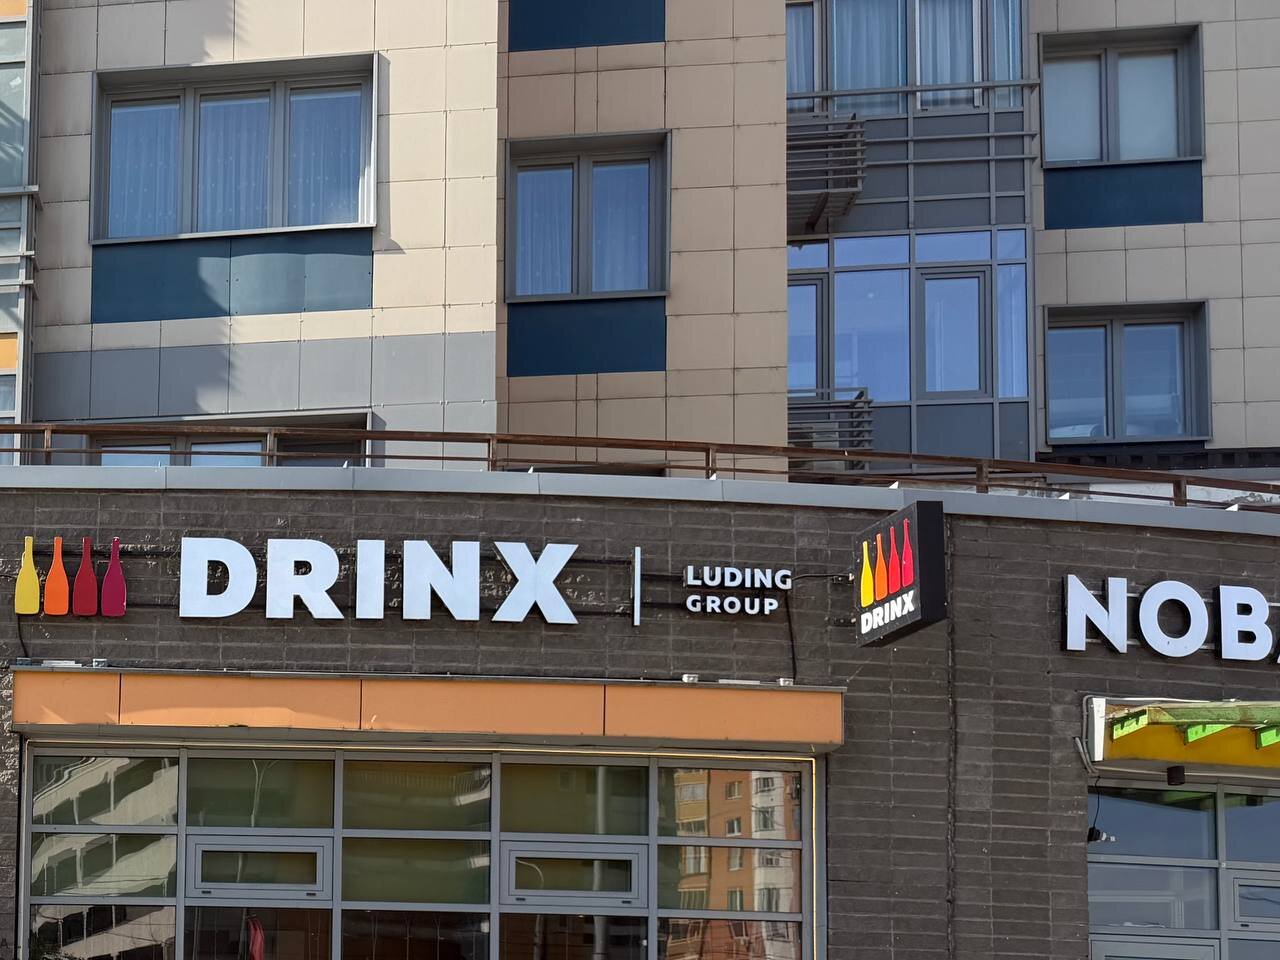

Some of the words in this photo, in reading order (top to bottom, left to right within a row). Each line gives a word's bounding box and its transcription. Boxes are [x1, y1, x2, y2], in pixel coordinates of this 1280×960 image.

[179, 537, 579, 624] DRINX
[687, 565, 792, 590] LUDING
[686, 594, 779, 615] GROUP
[860, 590, 915, 634] DRINX
[1066, 574, 1280, 664] NOB
